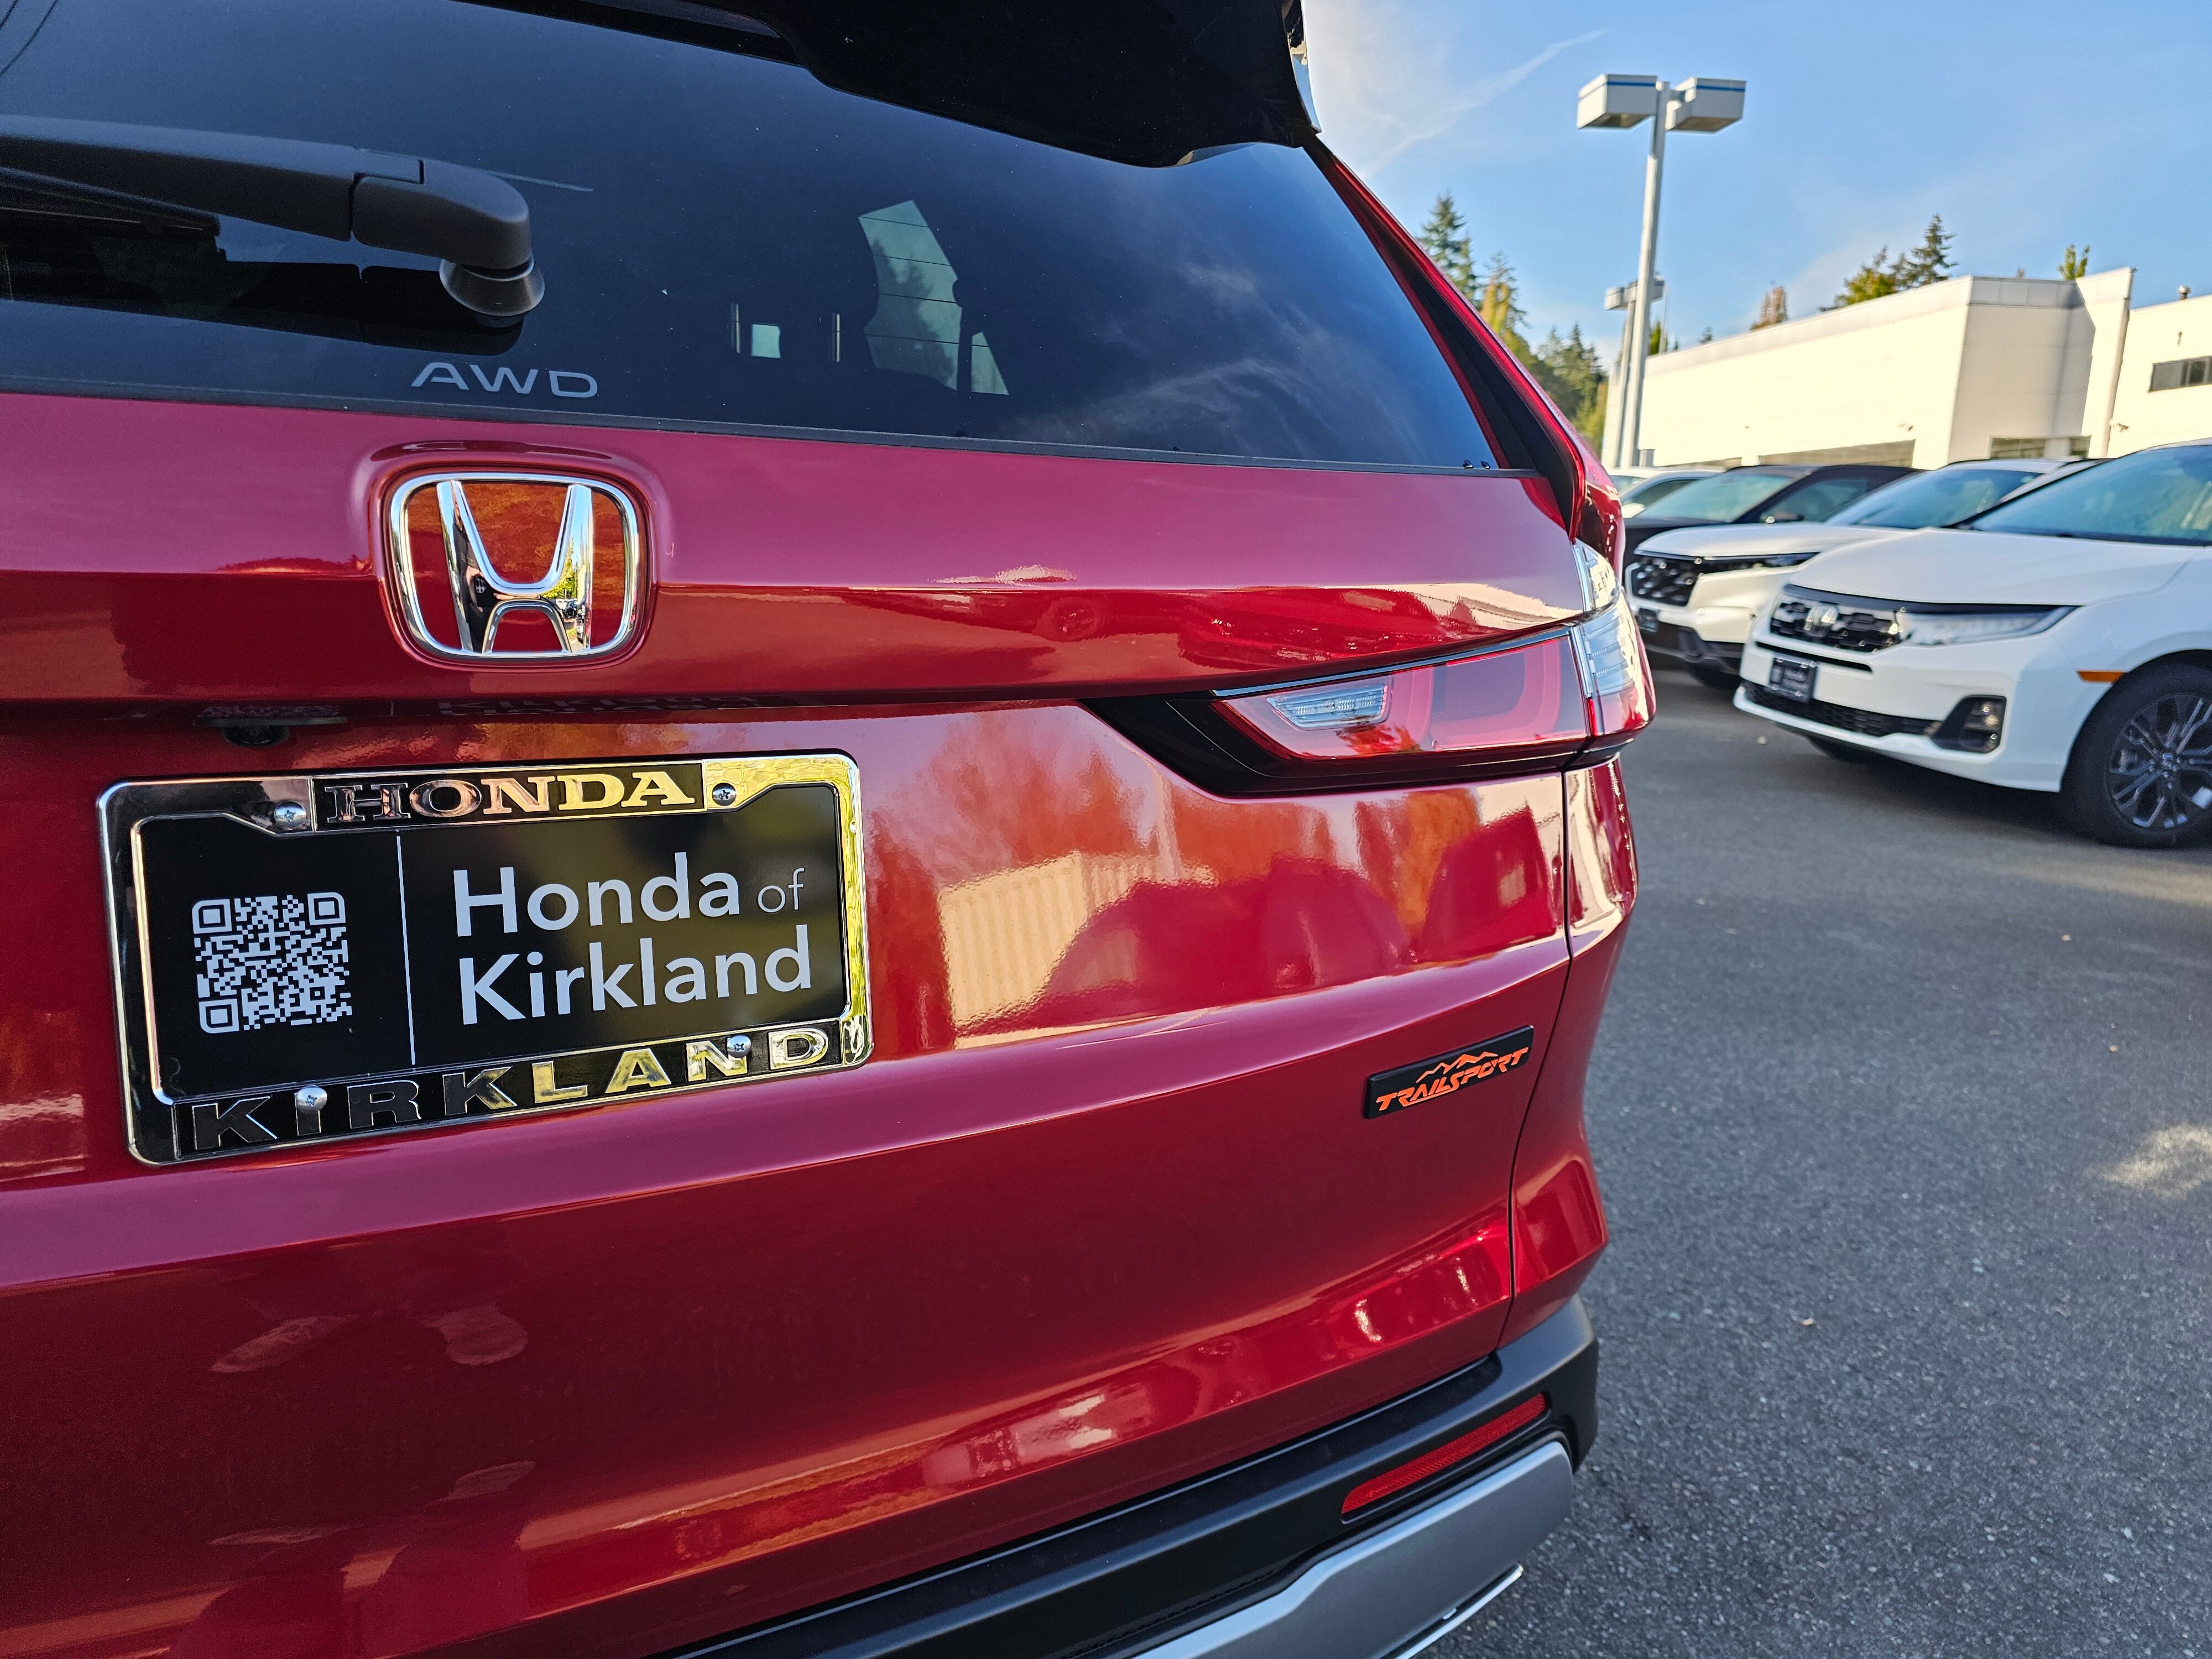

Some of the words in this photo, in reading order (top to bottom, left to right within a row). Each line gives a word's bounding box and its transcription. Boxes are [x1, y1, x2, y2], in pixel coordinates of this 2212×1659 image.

[411, 362, 598, 398] AWD
[325, 771, 695, 823] HONDA
[452, 852, 740, 937] Honda
[757, 867, 805, 914] of
[458, 925, 812, 1025] Kirkland
[192, 1027, 829, 1150] KIRKLAND
[1376, 1047, 1529, 1112] TRAILSPORT
